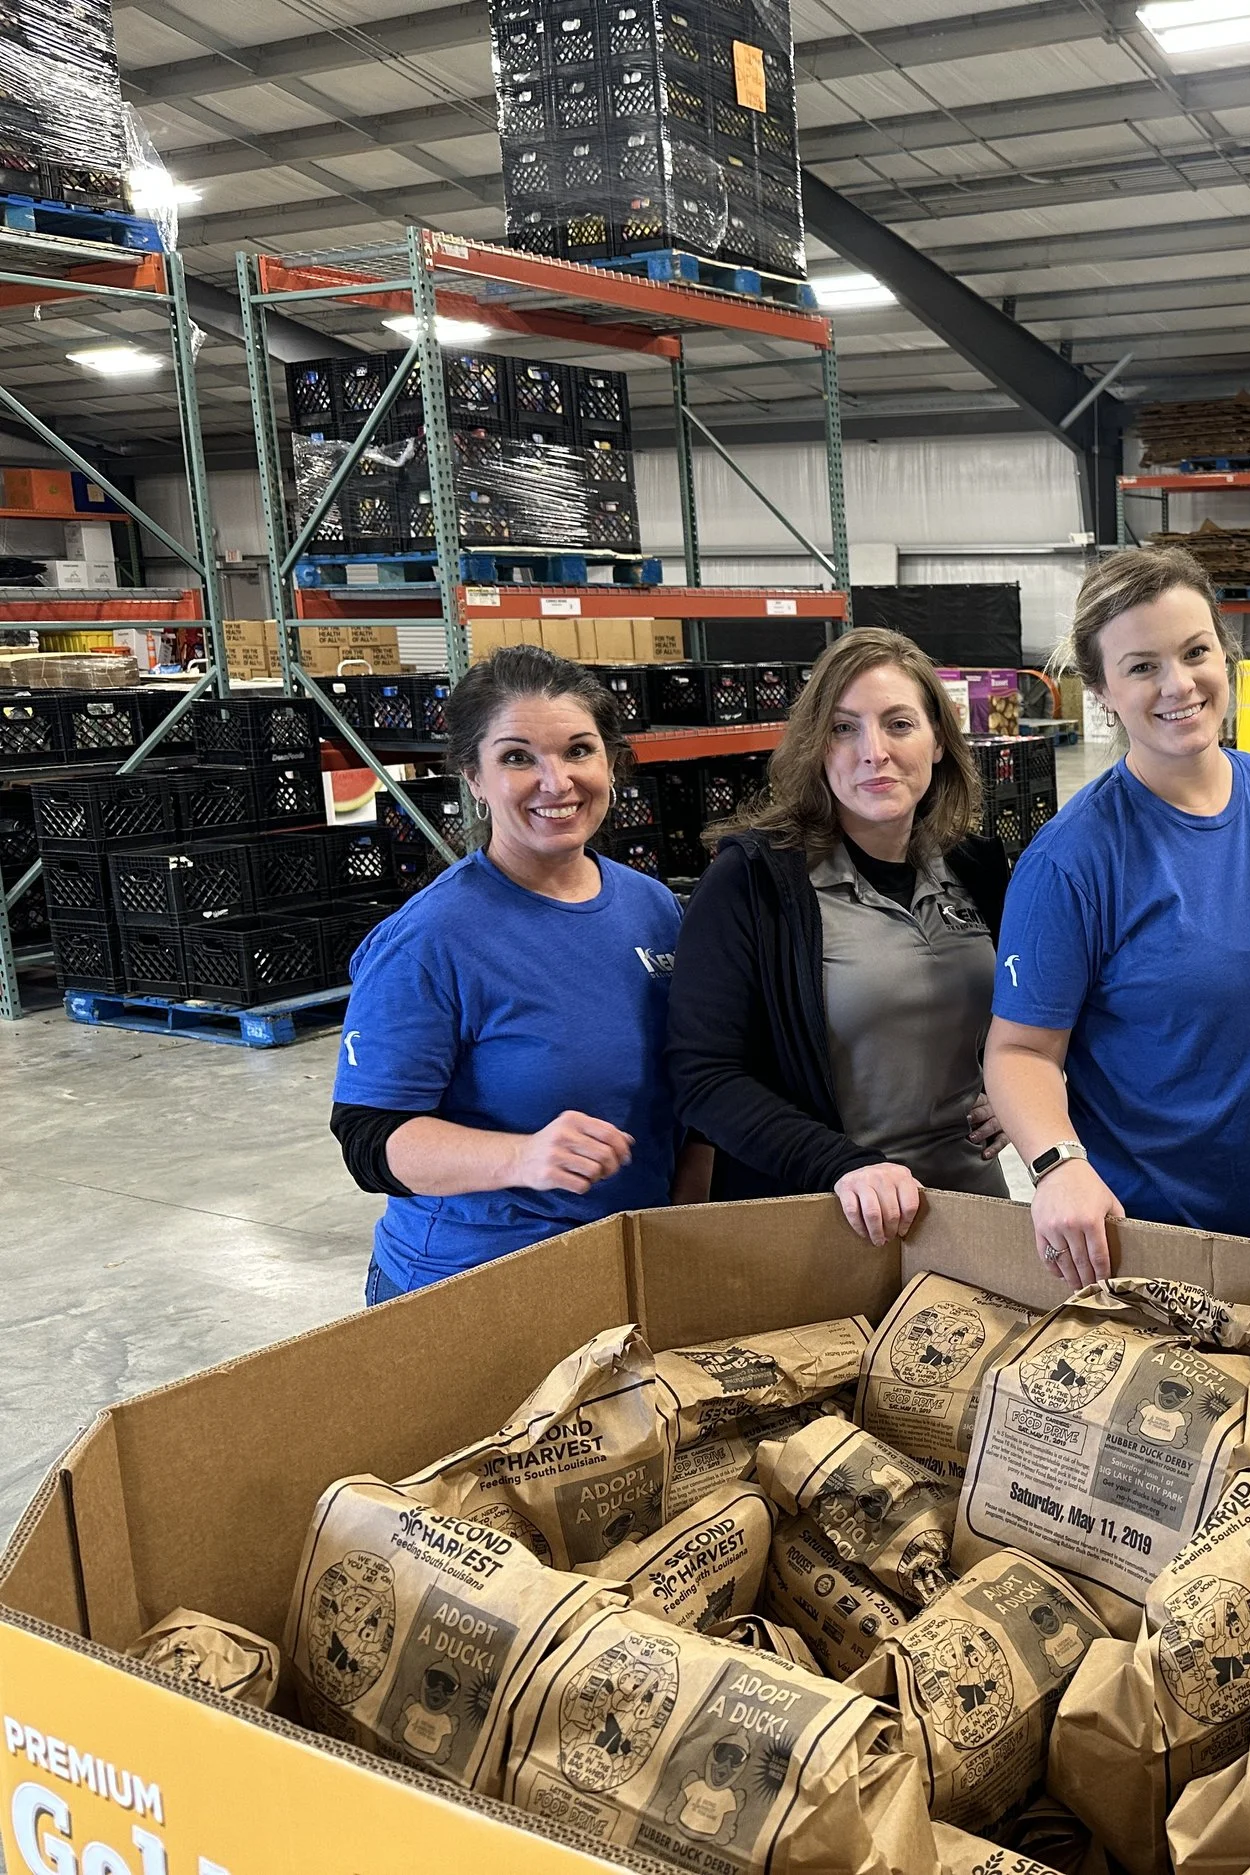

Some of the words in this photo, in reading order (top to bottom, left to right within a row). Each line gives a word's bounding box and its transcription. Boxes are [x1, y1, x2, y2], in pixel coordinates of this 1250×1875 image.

[634, 947, 676, 973] KEN
[1151, 1353, 1166, 1366] A
[1168, 1360, 1225, 1395] DUCK!
[1169, 1348, 1229, 1383] ADOPT
[1012, 1411, 1042, 1432] FOOD
[1043, 1420, 1079, 1444] DRIVE
[1022, 1407, 1044, 1418] LETTER
[479, 1474, 522, 1492] Feeding
[524, 1466, 557, 1482] South
[558, 1453, 607, 1473] Louisiana
[508, 1436, 604, 1472] HARVEST
[1106, 1433, 1138, 1452] RUBBER
[1140, 1445, 1163, 1461] DUCK
[1165, 1454, 1194, 1471] DERBY
[1111, 1457, 1142, 1476] Saturday
[1143, 1469, 1159, 1481] June
[576, 1507, 592, 1525] A
[598, 1480, 655, 1519] DUCK!
[580, 1465, 648, 1503] ADOPT
[1099, 1465, 1111, 1476] BIG
[1113, 1470, 1133, 1483] LAKE
[1134, 1477, 1144, 1488] IN
[1145, 1482, 1161, 1494] CITY
[1162, 1489, 1184, 1504] PARK
[1116, 1493, 1160, 1516] no-hunger.org
[429, 1513, 513, 1556] SECOND
[1010, 1482, 1064, 1524] Saturday,
[1067, 1504, 1096, 1534] May
[1100, 1518, 1118, 1543] 11,
[1120, 1525, 1152, 1556] 2019
[390, 1533, 422, 1559] Feeding
[420, 1549, 443, 1569] South
[441, 1562, 485, 1591] Louisiana
[421, 1525, 503, 1579] HARVEST
[664, 1519, 736, 1568] SECOND
[677, 1529, 745, 1585] HARVEST
[785, 1545, 816, 1574] ROUSES
[1171, 1541, 1213, 1575] Feeding
[1210, 1522, 1241, 1546] South
[663, 1584, 698, 1615] Feeding
[712, 1547, 749, 1574] Louisiana
[798, 1530, 841, 1573] Saturday,
[840, 1565, 863, 1589] May
[860, 1584, 876, 1604] 11,
[875, 1599, 900, 1627] 2019
[982, 1574, 1023, 1602] ADOPT
[1005, 1581, 1045, 1609] DUCK!
[1183, 1579, 1204, 1598] NEED
[433, 1602, 499, 1645] ADOPT
[418, 1624, 432, 1645] A
[435, 1630, 496, 1674] DUCK!
[729, 1673, 802, 1712] ADOPT
[707, 1695, 725, 1718] A
[729, 1702, 789, 1741] DUCK!
[3, 1714, 165, 1827] PREMIUM
[534, 1789, 571, 1817] FOOD
[570, 1807, 609, 1838] DRIVE
[640, 1823, 671, 1850] RUBBER
[672, 1841, 703, 1864] DUCK
[703, 1852, 740, 1875] DERBY
